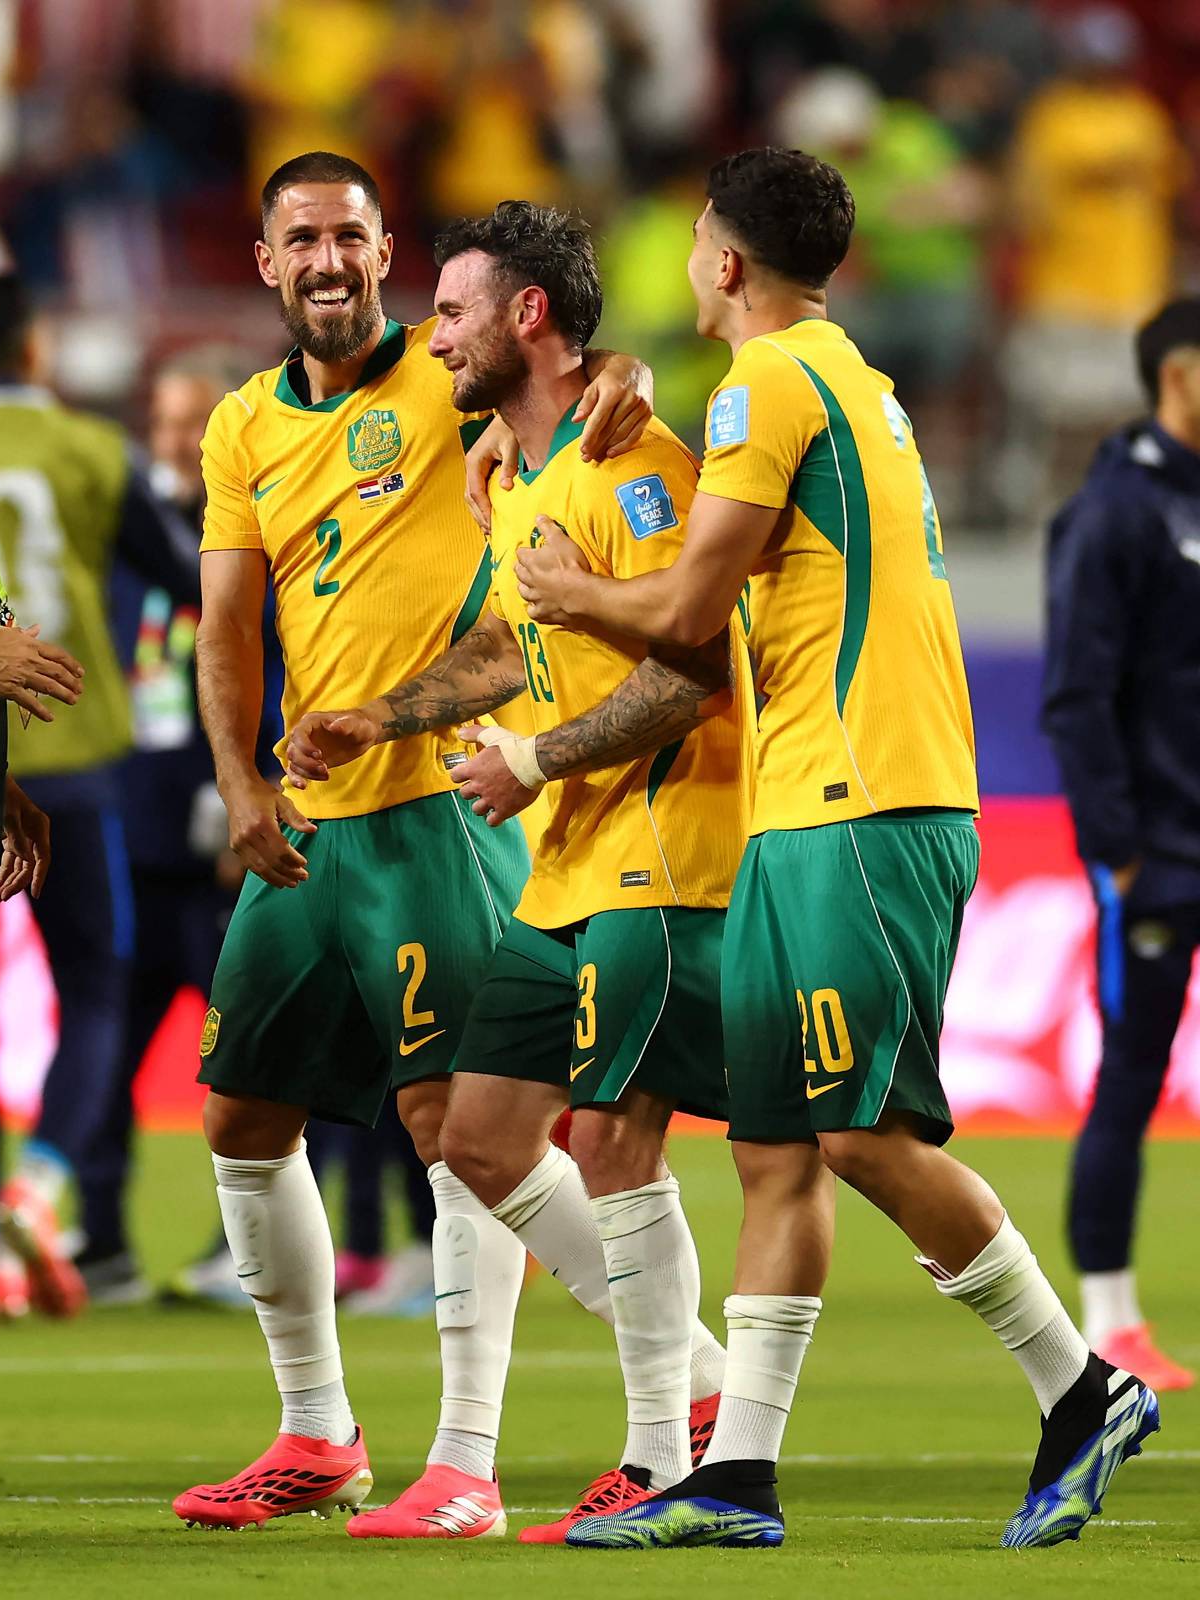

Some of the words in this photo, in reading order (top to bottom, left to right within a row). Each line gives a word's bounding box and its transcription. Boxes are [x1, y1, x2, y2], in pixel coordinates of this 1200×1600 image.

[640, 508, 663, 524] PEACE
[313, 519, 341, 597] 2
[518, 622, 555, 702] 13
[397, 943, 435, 1028] 2
[575, 963, 597, 1050] 3
